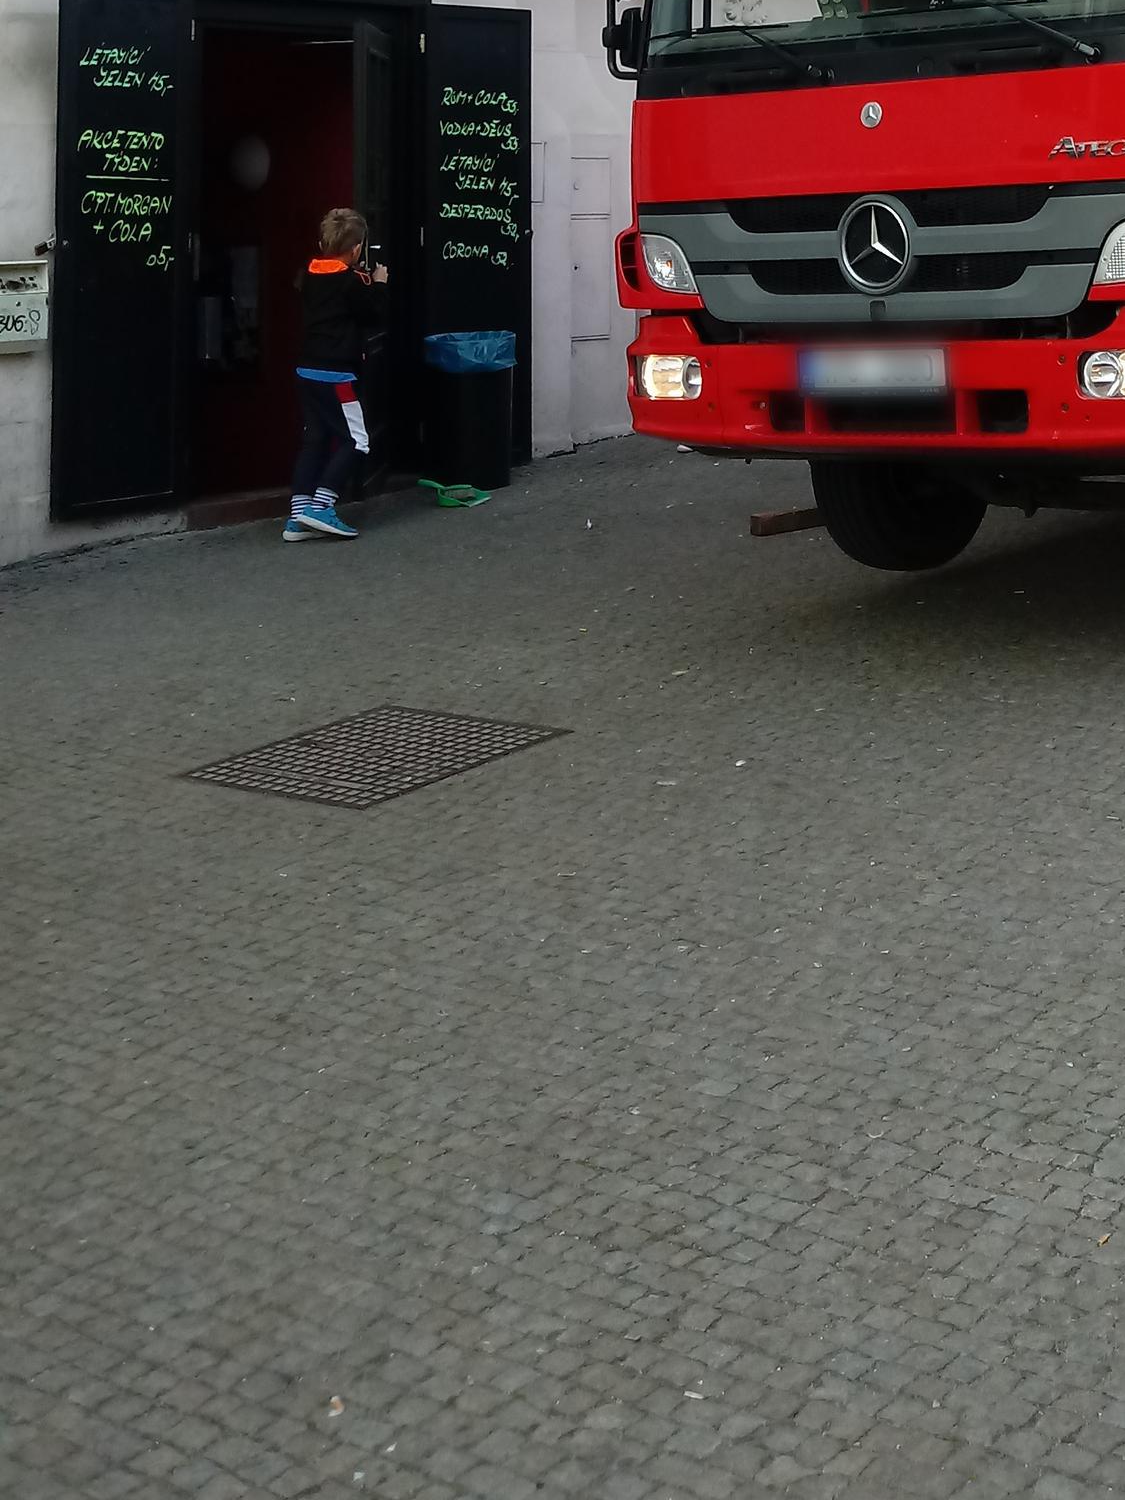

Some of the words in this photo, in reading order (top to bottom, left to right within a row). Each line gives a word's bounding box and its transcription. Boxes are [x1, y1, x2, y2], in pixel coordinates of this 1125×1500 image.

[77, 129, 126, 151] AKCE
[126, 130, 165, 150] TENTO
[439, 203, 512, 224] DESPERADOS
[108, 219, 152, 243] COLA
[442, 240, 489, 261] CORONA
